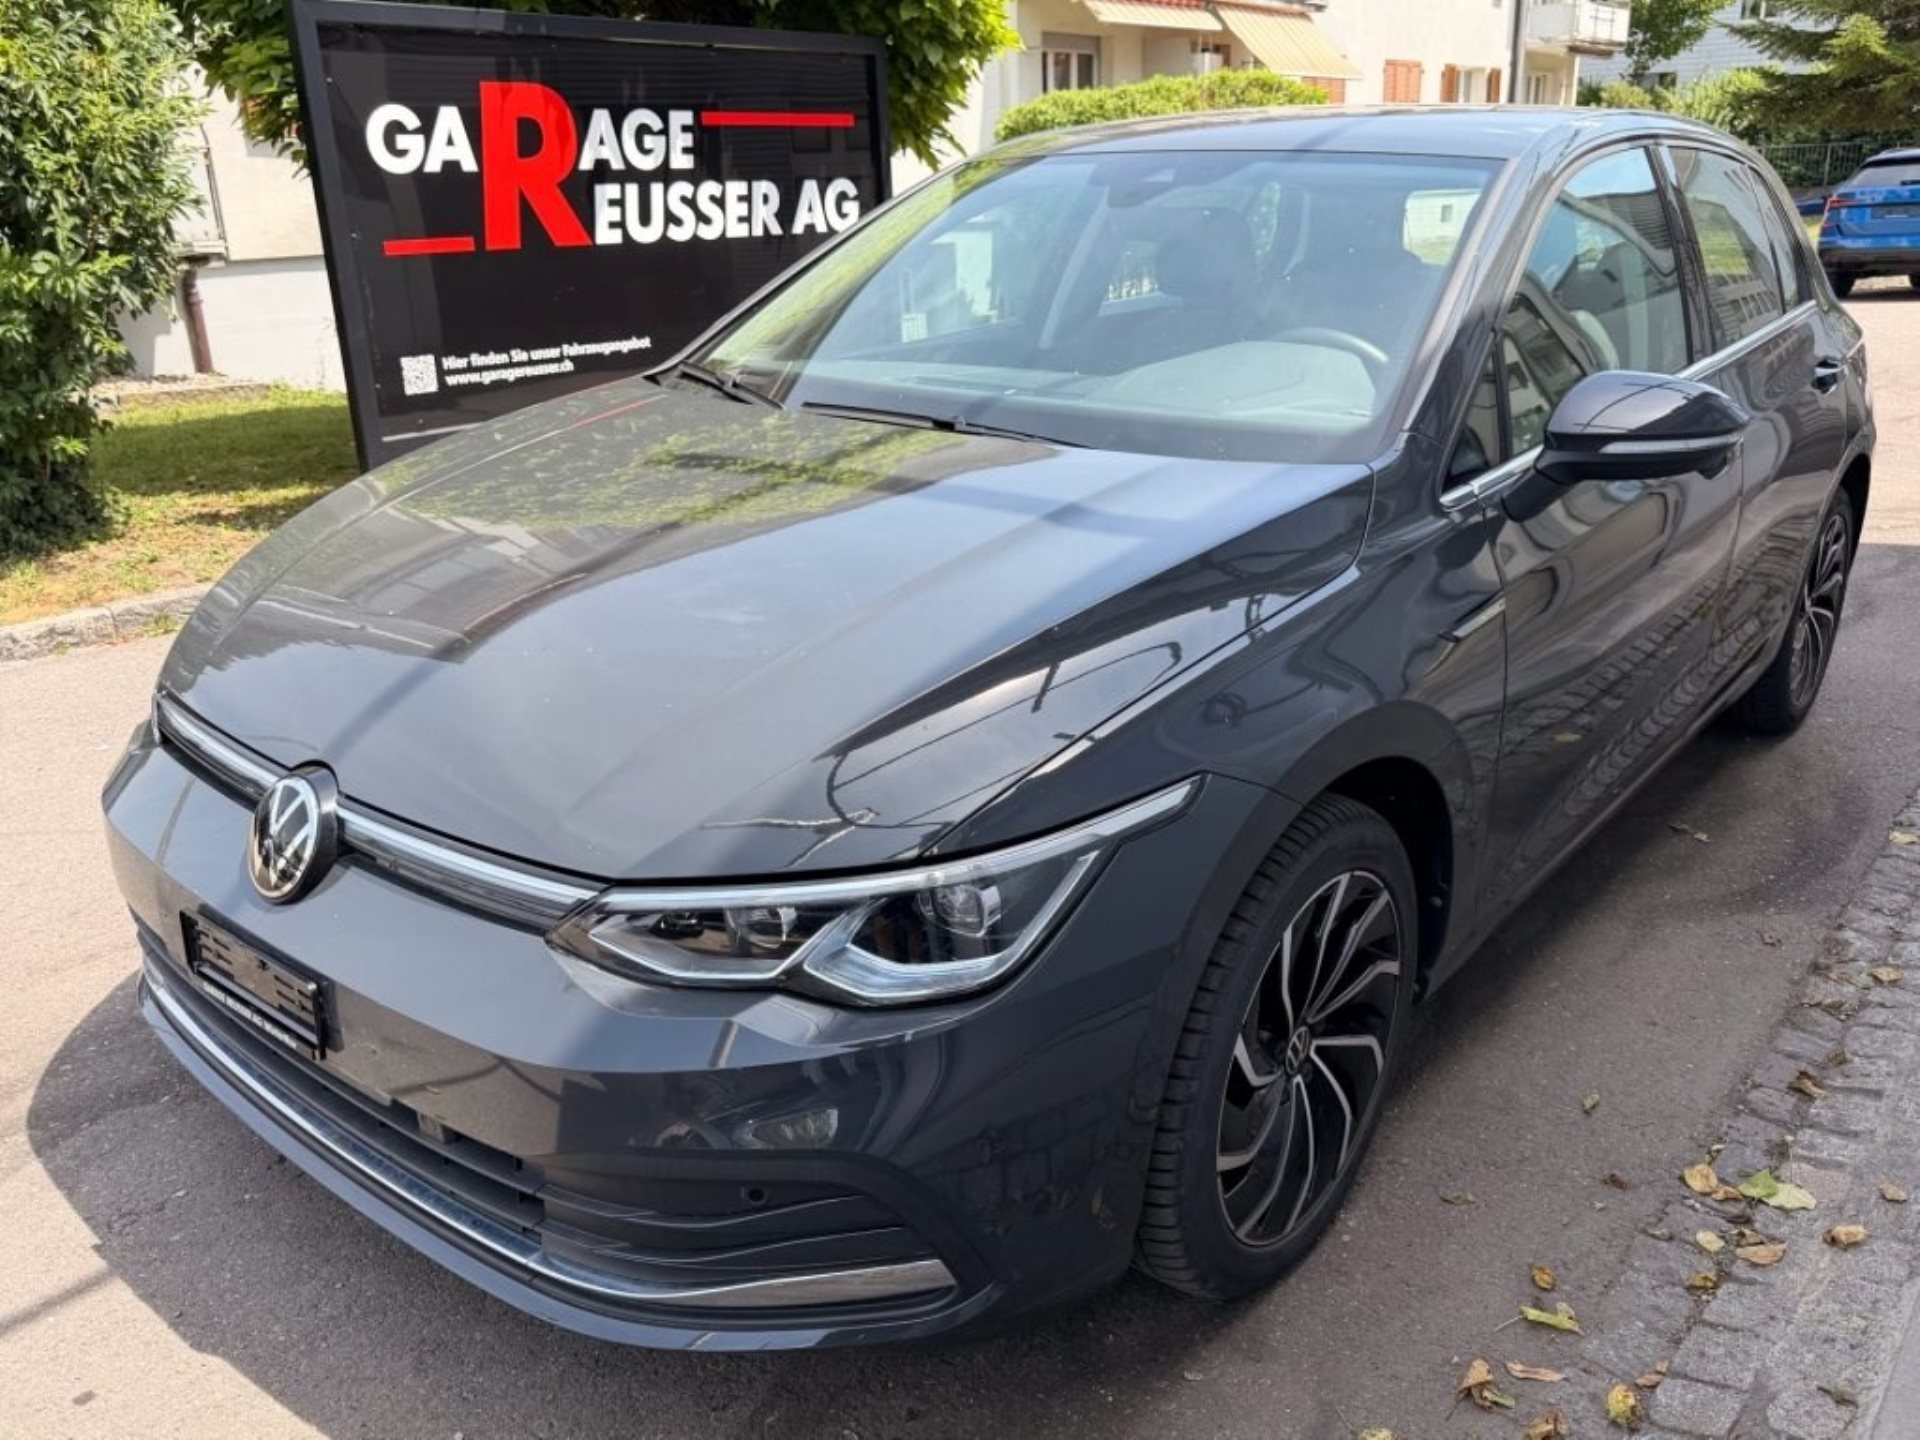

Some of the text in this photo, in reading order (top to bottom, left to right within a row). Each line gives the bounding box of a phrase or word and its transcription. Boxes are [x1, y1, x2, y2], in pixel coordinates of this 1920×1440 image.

[365, 80, 695, 251] GARAGE
[791, 177, 860, 236] AG
[441, 356, 469, 370] Hier
[470, 352, 510, 367] finden
[510, 348, 529, 362] Sie
[530, 347, 561, 360] unser
